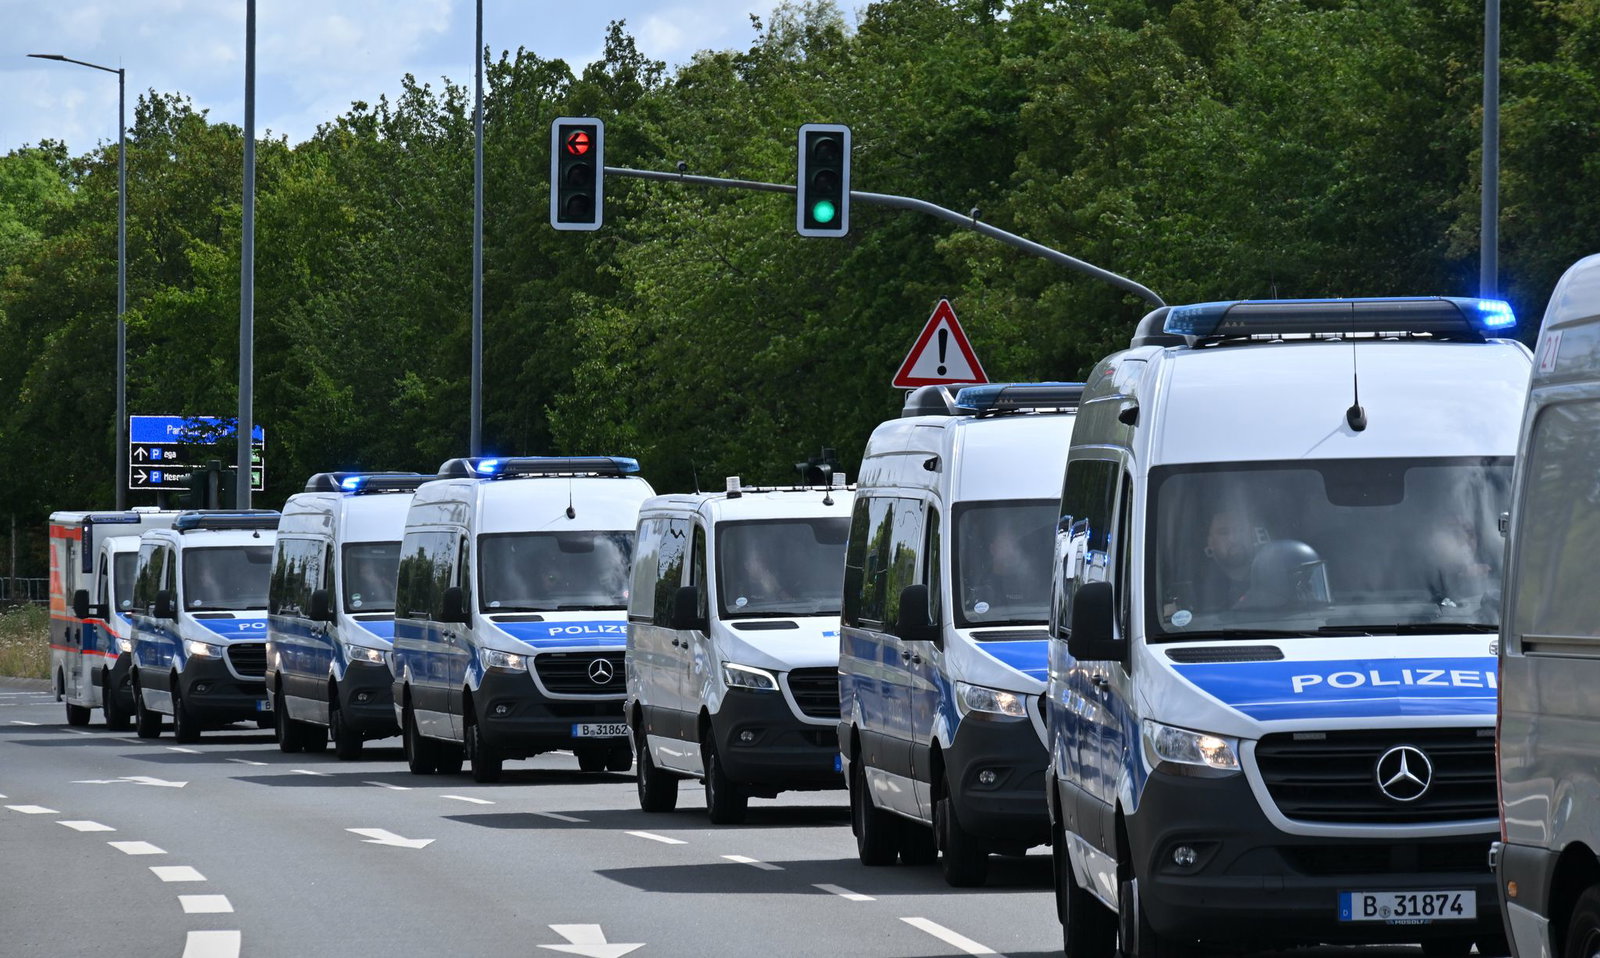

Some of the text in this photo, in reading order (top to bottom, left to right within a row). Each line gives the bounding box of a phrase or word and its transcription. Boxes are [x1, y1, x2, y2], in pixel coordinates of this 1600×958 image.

[1541, 335, 1559, 369] 21
[152, 448, 177, 460] P ega
[152, 471, 160, 482] P
[1291, 668, 1498, 693] POLIZEI
[582, 724, 628, 735] B 31862
[1363, 895, 1377, 917] B
[1393, 893, 1463, 917] 31874
